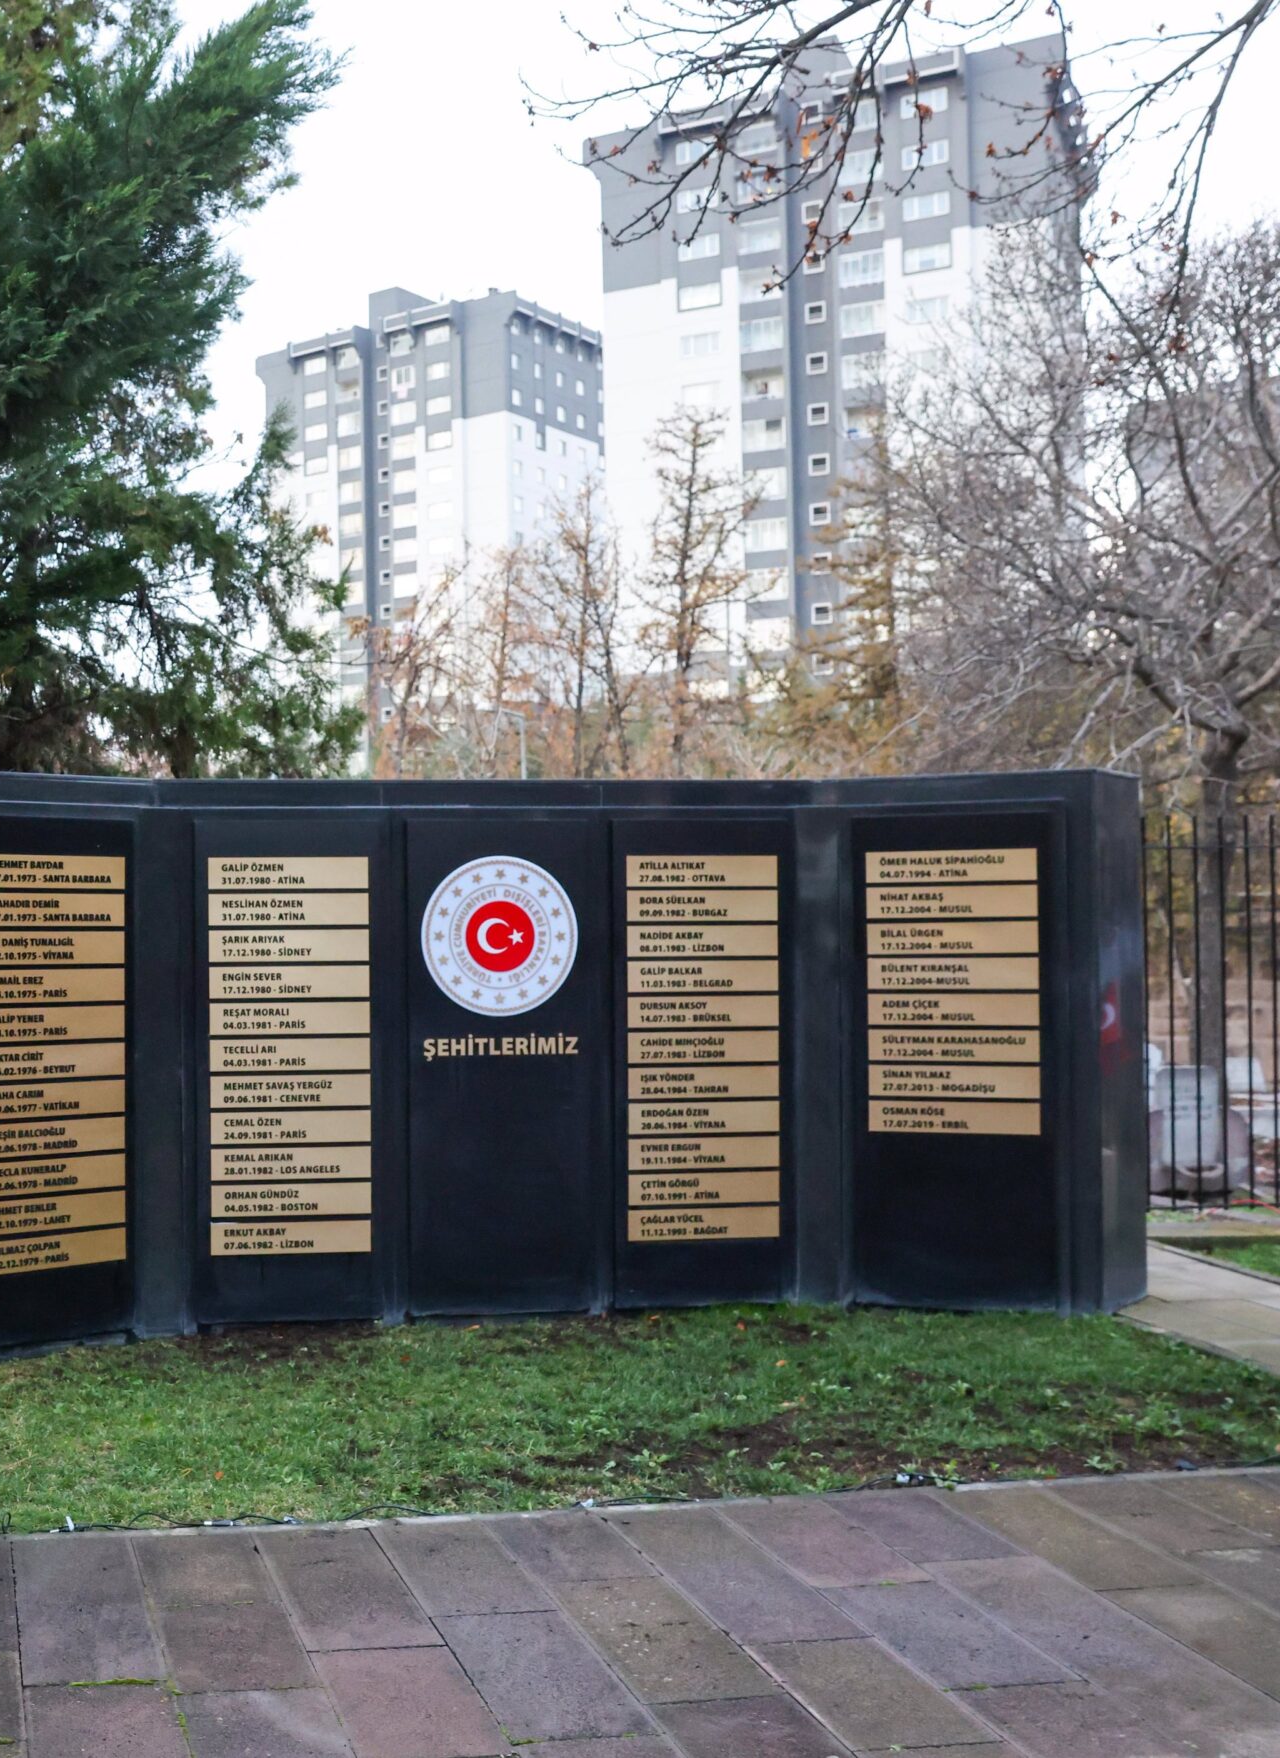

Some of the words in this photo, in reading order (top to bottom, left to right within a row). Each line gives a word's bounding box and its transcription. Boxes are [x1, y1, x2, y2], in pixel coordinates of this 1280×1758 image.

[29, 860, 63, 870] BAYDAR
[639, 861, 668, 870] ATİLLA
[670, 861, 705, 870] ALTIKAT
[879, 856, 907, 866] ÖMER
[909, 856, 941, 865] HALUK
[220, 862, 249, 872] GALİP
[250, 862, 283, 871] ÖZMEN
[938, 868, 967, 877] ATİNA
[42, 874, 70, 883] SANTA
[71, 874, 111, 884] BARBARA
[221, 876, 270, 885] 31.07.1980
[277, 874, 305, 884] ATİNA
[691, 874, 725, 882] OTTAVA
[639, 896, 663, 904] BORA
[880, 892, 908, 901] NİHAT
[911, 892, 943, 902] AKBAŞ
[31, 898, 59, 908] DEMİR
[221, 898, 268, 908] NESLİHAN
[269, 898, 302, 908] ÖZMEN
[692, 908, 727, 917] BURGAZ
[938, 905, 972, 913] MUSUL
[42, 913, 70, 922] SANTA
[71, 913, 111, 922] BARBARA
[221, 912, 271, 921] 31.07.1980
[277, 911, 305, 920] ATİNA
[639, 931, 673, 940] NADİDE
[675, 931, 703, 939] AKBAY
[880, 929, 906, 938] BİLAL
[910, 927, 943, 937] ÜRGEN
[1, 936, 28, 948] DANİŞ
[221, 935, 249, 945] ŞARIK
[251, 935, 284, 943] ARIYAK
[939, 941, 973, 949] MUSUL
[222, 948, 271, 957] 17.12.1980
[278, 946, 311, 956] SİDNEY
[692, 943, 724, 952] LİZBON
[42, 949, 74, 960] VİYANA
[640, 966, 666, 975] GALİP
[667, 966, 702, 975] BALKAR
[881, 963, 918, 972] BÜLENT
[22, 976, 43, 985] EREZ
[222, 971, 251, 981] ENGİN
[252, 972, 281, 981] SEVER
[692, 979, 733, 987] BELGRAD
[42, 987, 67, 997] PARİS
[222, 985, 271, 994] 17.12.1980
[278, 983, 311, 993] SİDNEY
[639, 1001, 676, 1010] DURSUN
[678, 1001, 707, 1009] AKSOY
[881, 1000, 909, 1008] ADEM
[222, 1008, 251, 1018] REŞAT
[253, 1007, 289, 1016] MORALI
[692, 1012, 731, 1022] BRÜKSEL
[940, 1013, 974, 1021] MUSUL
[16, 1014, 44, 1023] YENER
[222, 1021, 271, 1030] 04.03.1981
[278, 1019, 305, 1029] PARİS
[42, 1026, 67, 1036] PARİS
[640, 1038, 672, 1046] CAHİDE
[882, 1035, 934, 1044] SÜLEYMAN
[222, 1044, 258, 1054] TECELLİ
[260, 1045, 276, 1053] ARI
[423, 1032, 579, 1062] ŞEHİTLERİMİZ
[21, 1050, 43, 1061] CİRİT
[693, 1049, 725, 1058] LİZBON
[940, 1049, 974, 1057] MUSUL
[222, 1058, 271, 1067] 04.03.1981
[279, 1056, 306, 1066] PARİS
[42, 1064, 75, 1074] BEYRUT
[882, 1069, 912, 1078] SİNAN
[914, 1070, 950, 1079] YILMAZ
[659, 1072, 694, 1081] YÖNDER
[223, 1081, 263, 1090] MEHMET
[265, 1081, 294, 1091] SAVAŞ
[296, 1079, 332, 1089] YERGÜZ
[693, 1085, 728, 1093] TAHRAN
[223, 1094, 272, 1103] 09.06.1981
[279, 1093, 320, 1102] CENEVRE
[43, 1099, 79, 1111] VATİKAN
[641, 1107, 683, 1117] ERDOĞAN
[685, 1107, 709, 1116] ÖZEN
[882, 1106, 917, 1115] OSMAN
[920, 1106, 944, 1116] KÖSE
[223, 1118, 254, 1127] CEMAL
[256, 1116, 281, 1126] ÖZEN
[693, 1119, 726, 1128] VİYANA
[223, 1131, 272, 1140] 24.09.1981
[280, 1129, 306, 1139] PARİS
[43, 1138, 77, 1150] MADRİD
[223, 1153, 255, 1162] KEMAL
[257, 1152, 293, 1161] ARIKAN
[693, 1154, 725, 1163] VİYANA
[224, 1166, 273, 1175] 28.01.1982
[280, 1165, 297, 1174] LOS
[298, 1164, 340, 1173] ANGELES
[43, 1174, 77, 1187] MADRİD
[640, 1179, 666, 1190] ÇETİN
[224, 1191, 257, 1199] ORHAN
[259, 1188, 299, 1199] GÜNDÜZ
[693, 1190, 719, 1199] ATİNA
[224, 1203, 273, 1212] 04.05.1982
[280, 1202, 318, 1211] BOSTON
[640, 1214, 675, 1226] ÇAĞLAR
[223, 1228, 254, 1237] ERKUT
[255, 1227, 286, 1236] AKBAY
[280, 1238, 313, 1248] LİZBON
[44, 1252, 69, 1263] PARİS
